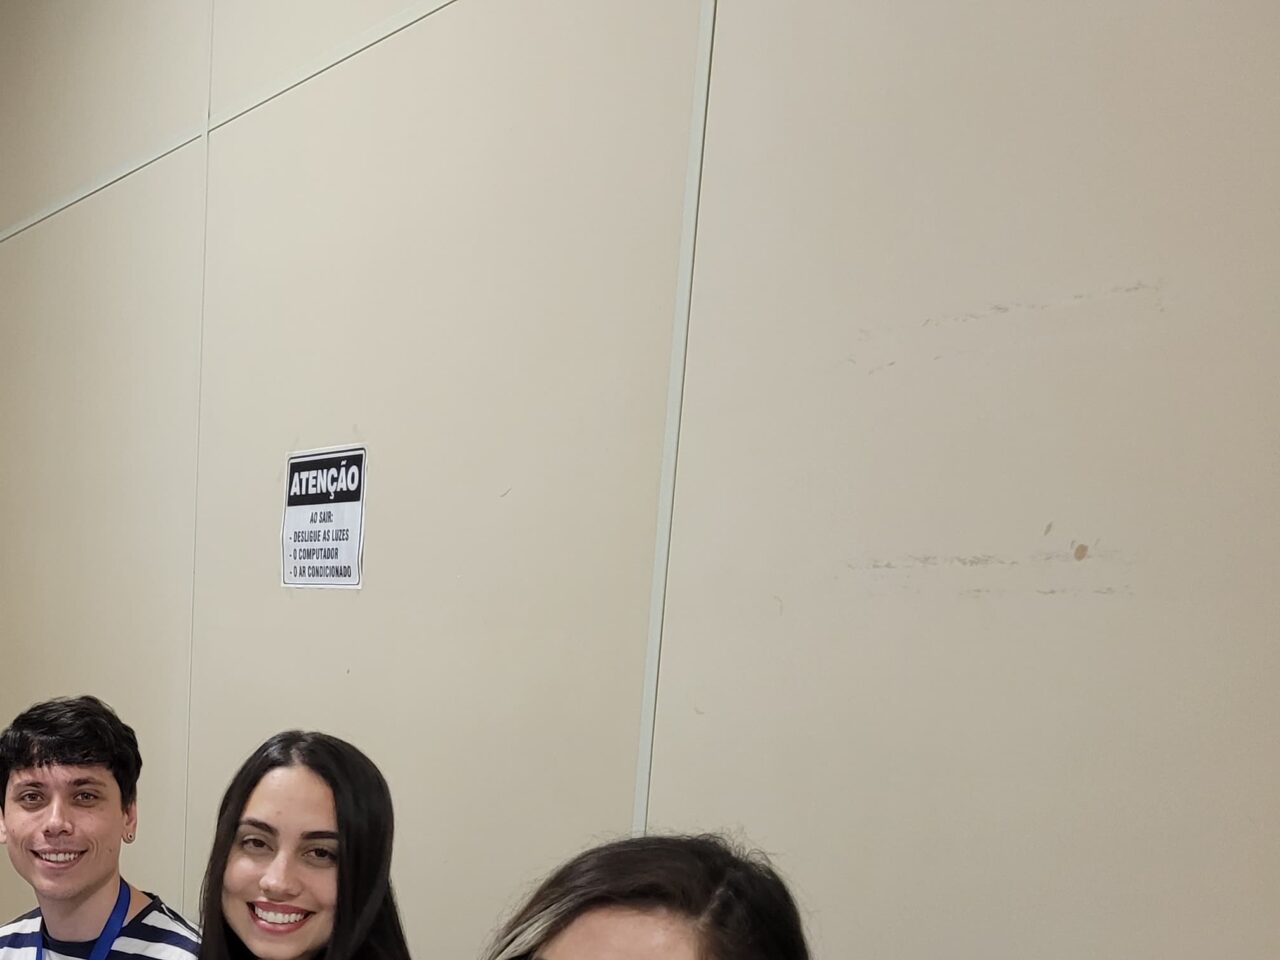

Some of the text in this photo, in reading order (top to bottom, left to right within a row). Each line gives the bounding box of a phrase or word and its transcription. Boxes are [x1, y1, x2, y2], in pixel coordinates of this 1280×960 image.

[290, 460, 359, 499] ATENÇÃO
[309, 511, 334, 524] AO SAIR:
[293, 529, 349, 543] DESLIGUE AS LUZES
[293, 547, 339, 560] O COMPUTADOR
[293, 565, 352, 578] O AR CONDICIONADO
